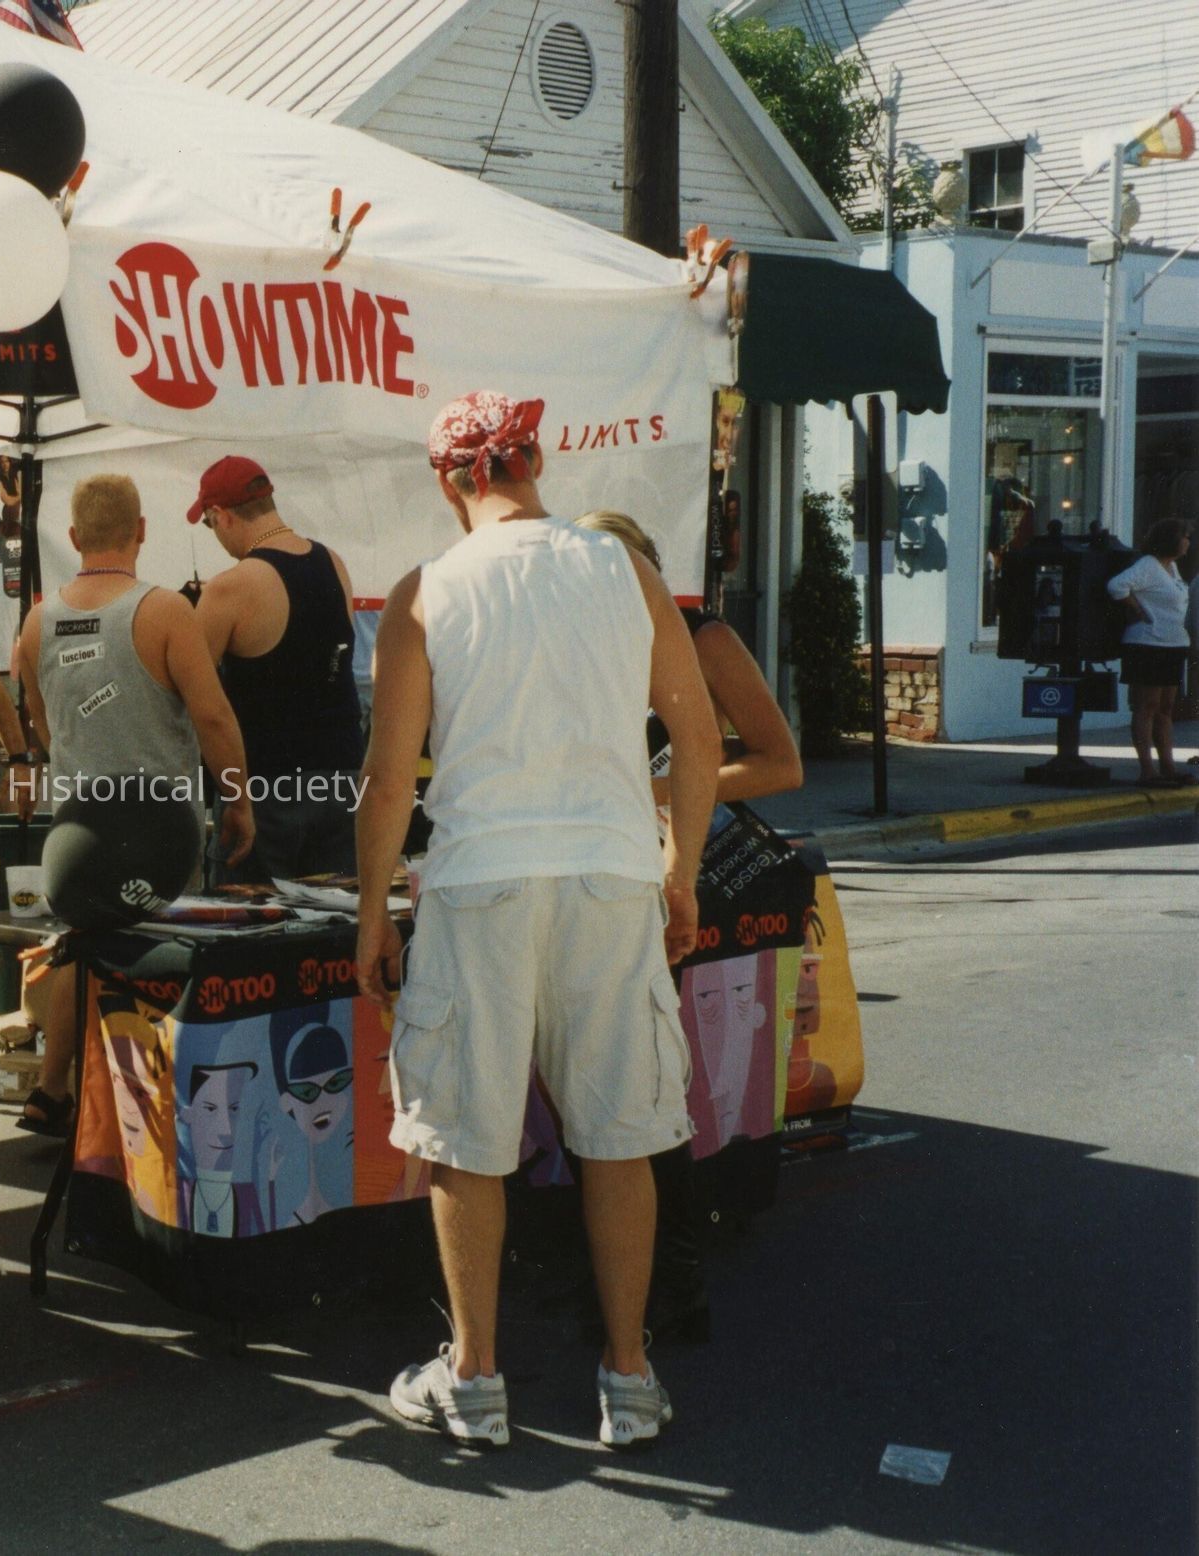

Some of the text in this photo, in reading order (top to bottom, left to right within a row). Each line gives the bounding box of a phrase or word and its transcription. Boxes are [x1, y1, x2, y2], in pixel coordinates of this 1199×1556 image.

[558, 414, 664, 451] LIMITS
[697, 926, 720, 949] OO
[323, 957, 358, 983] TO
